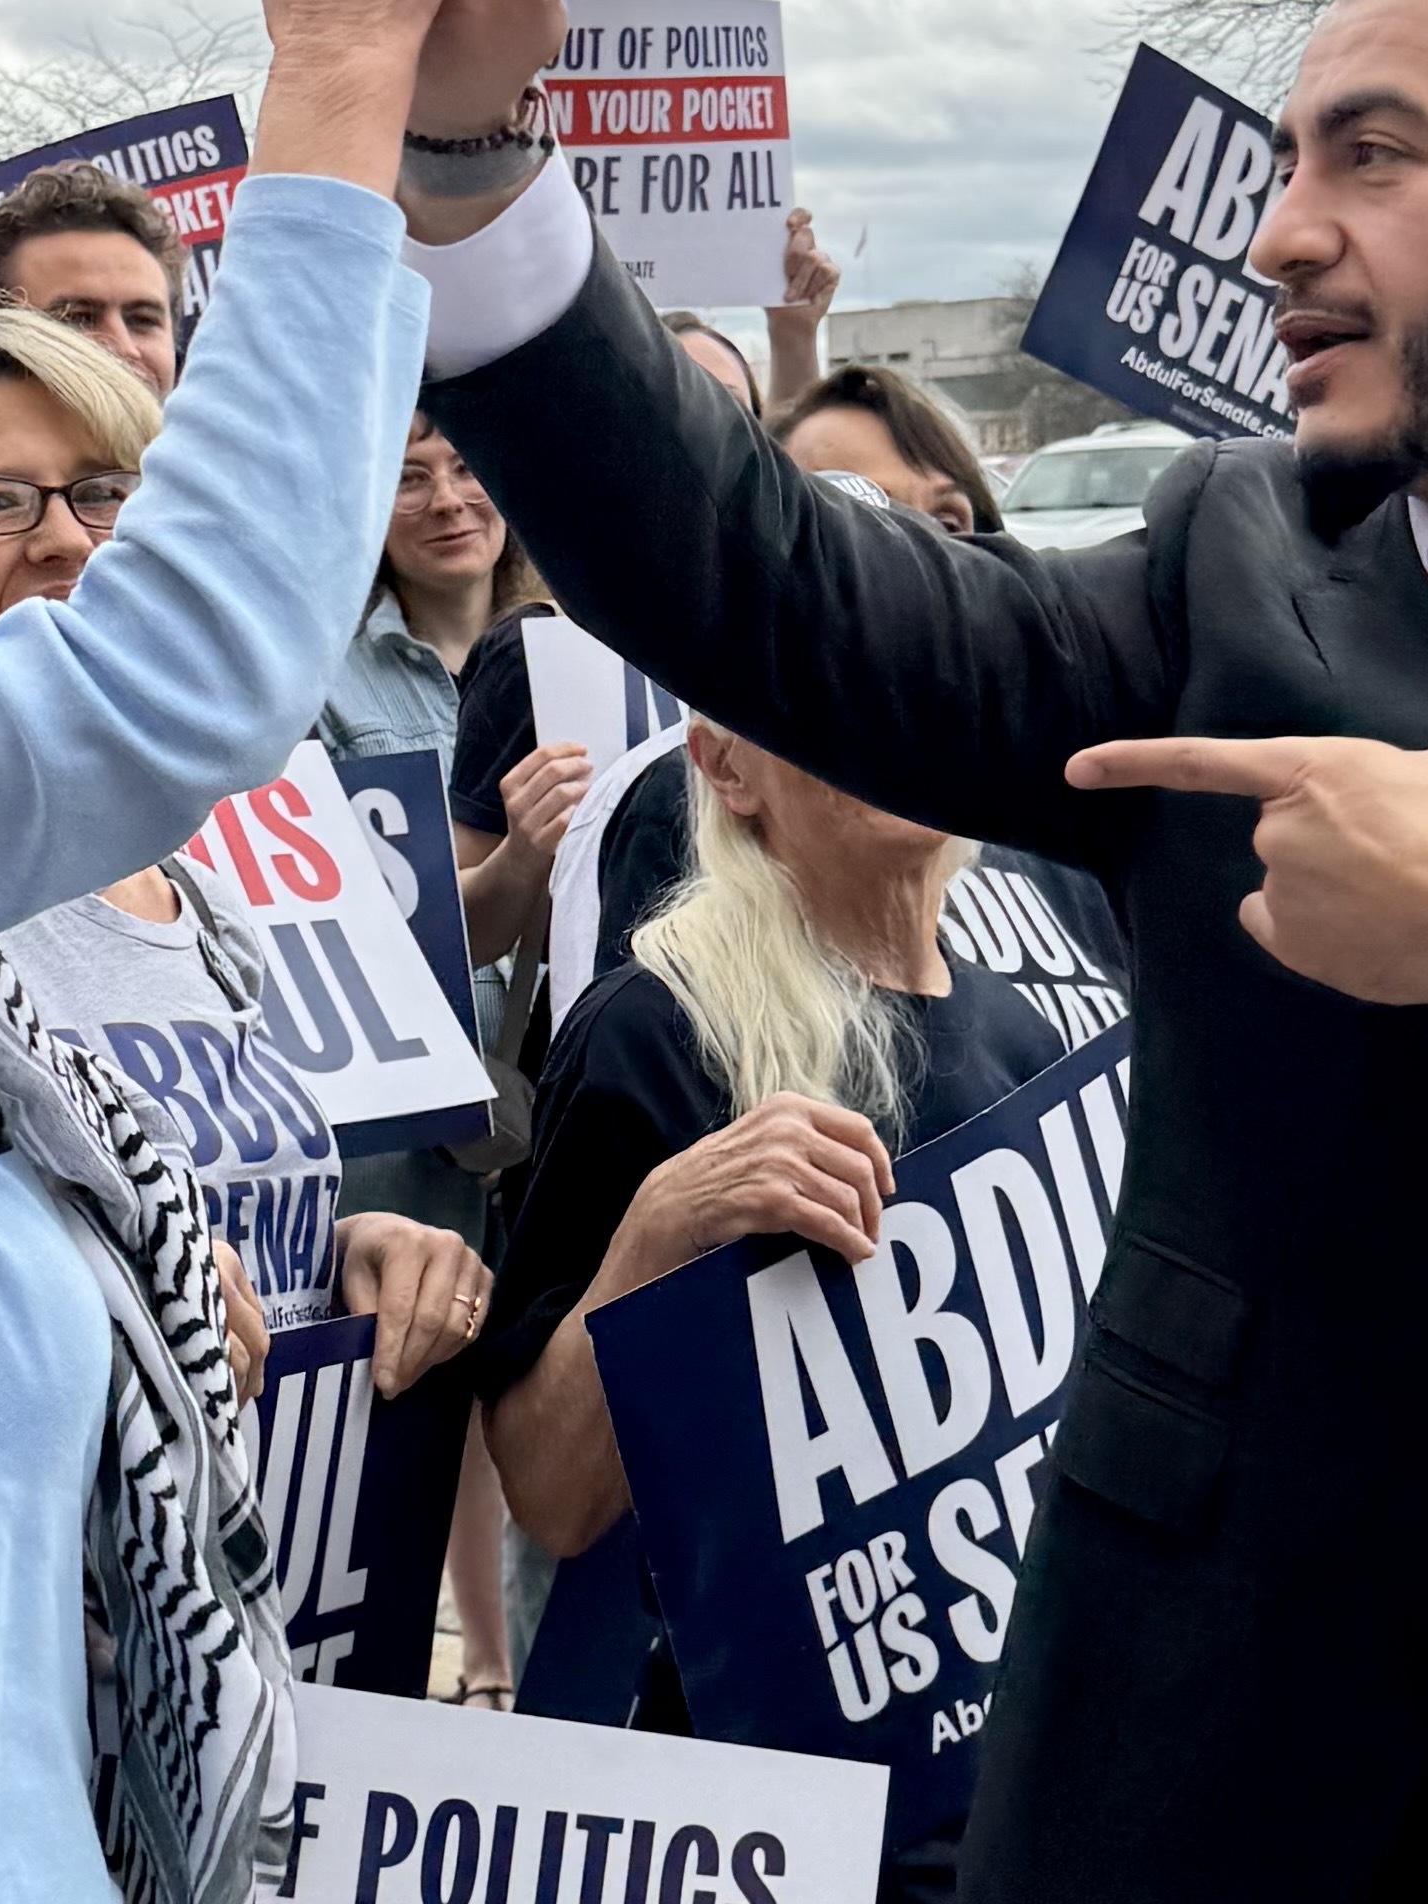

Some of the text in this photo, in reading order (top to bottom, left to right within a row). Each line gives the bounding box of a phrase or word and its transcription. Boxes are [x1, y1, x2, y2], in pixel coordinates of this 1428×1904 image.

[545, 25, 769, 71] UT OF POLITICS
[587, 89, 671, 135] YOUR
[682, 86, 773, 133] POCKET
[641, 153, 710, 214] FOR
[726, 150, 782, 211] ALL
[1120, 236, 1177, 287] FOR
[1105, 275, 1163, 334] US
[804, 1530, 916, 1649] FOR
[826, 1593, 941, 1724] US
